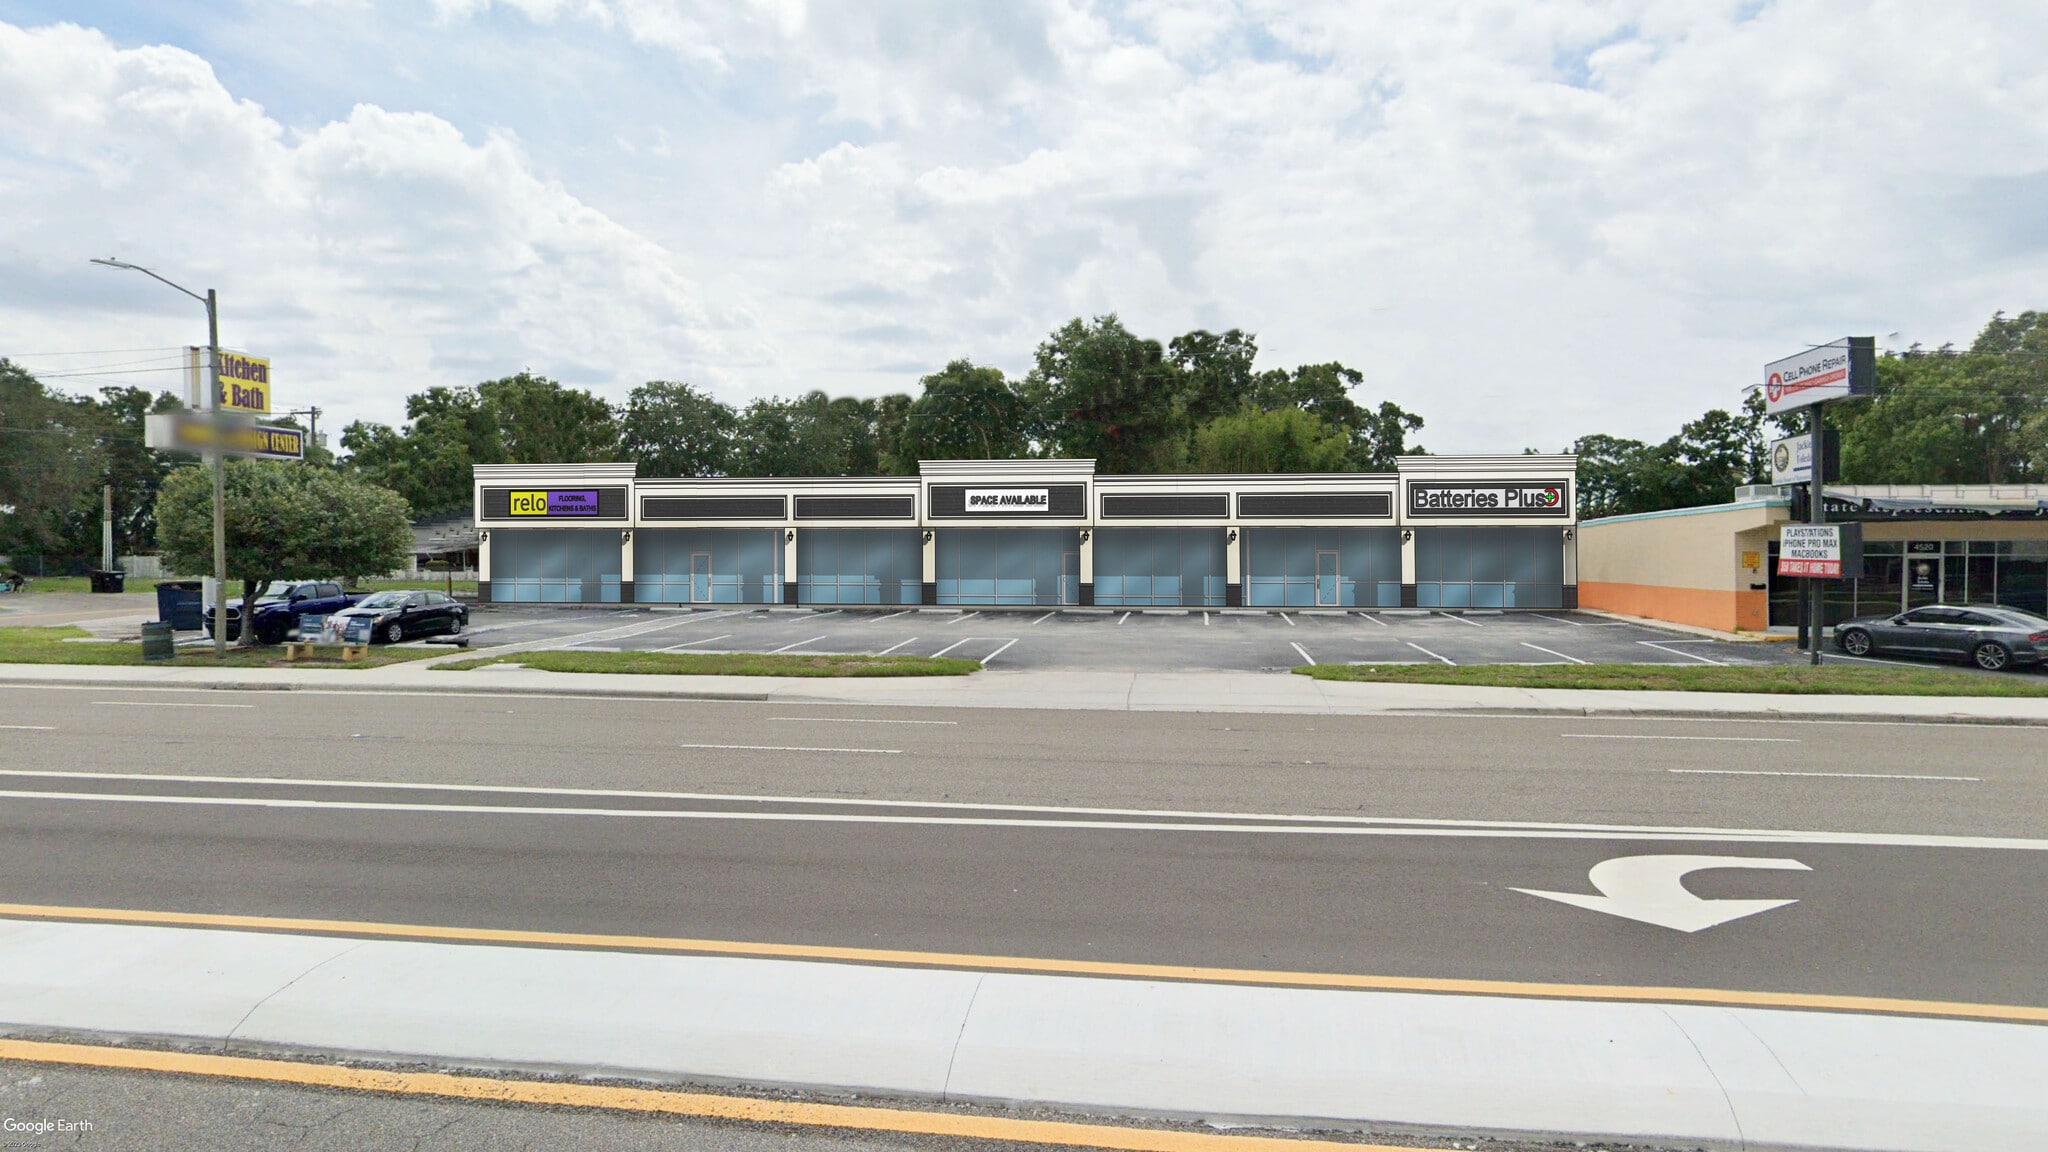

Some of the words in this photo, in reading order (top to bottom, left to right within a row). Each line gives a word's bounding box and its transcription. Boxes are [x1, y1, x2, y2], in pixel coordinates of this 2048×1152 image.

[232, 384, 264, 410] Bath
[271, 432, 299, 454] CENTER
[513, 493, 546, 511] relo
[970, 495, 998, 505] SPACE
[1000, 495, 1047, 505] AVAILABLE
[1415, 489, 1498, 508] Batteries
[1504, 489, 1546, 508] Plus
[1786, 528, 1834, 537] PLAYSTATIONS
[1807, 539, 1821, 548] PRO
[1822, 539, 1838, 548] MAX
[1791, 549, 1828, 558] MACBOOKS
